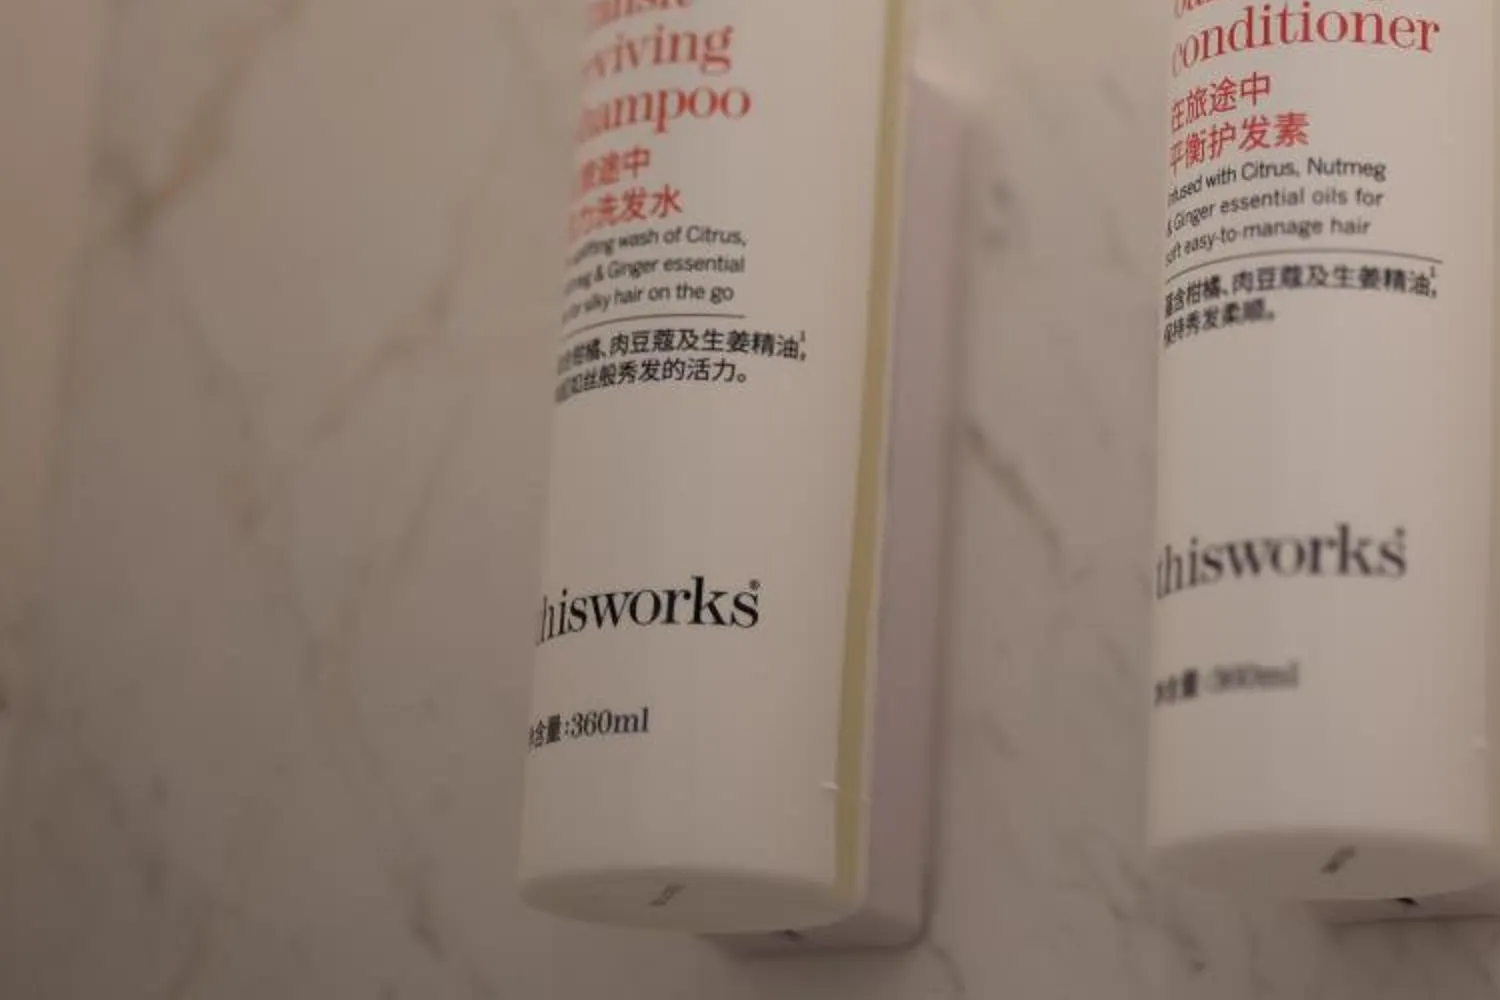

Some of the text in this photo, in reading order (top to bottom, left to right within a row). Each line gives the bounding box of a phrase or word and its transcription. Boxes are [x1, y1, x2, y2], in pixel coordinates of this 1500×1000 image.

[1171, 1, 1440, 77] conditioner
[1169, 112, 1310, 177] 平衡护发素
[1206, 166, 1237, 188] with
[1241, 160, 1300, 181] Citrus,
[1307, 157, 1387, 182] Nutmeg
[1174, 204, 1216, 231] Ginger
[1220, 187, 1305, 213] essential
[1312, 187, 1348, 206] oils
[1355, 187, 1384, 207] for
[1330, 216, 1371, 236] hair
[618, 228, 660, 249] wash
[663, 226, 682, 246] of
[685, 224, 747, 249] Citrus,
[607, 259, 658, 280] Ginger
[663, 255, 745, 274] essential
[613, 285, 643, 305] hair
[648, 286, 670, 301] on
[676, 283, 705, 301] the
[710, 286, 735, 304] go
[1155, 522, 1407, 600] thisworks
[536, 575, 760, 646] hisworks
